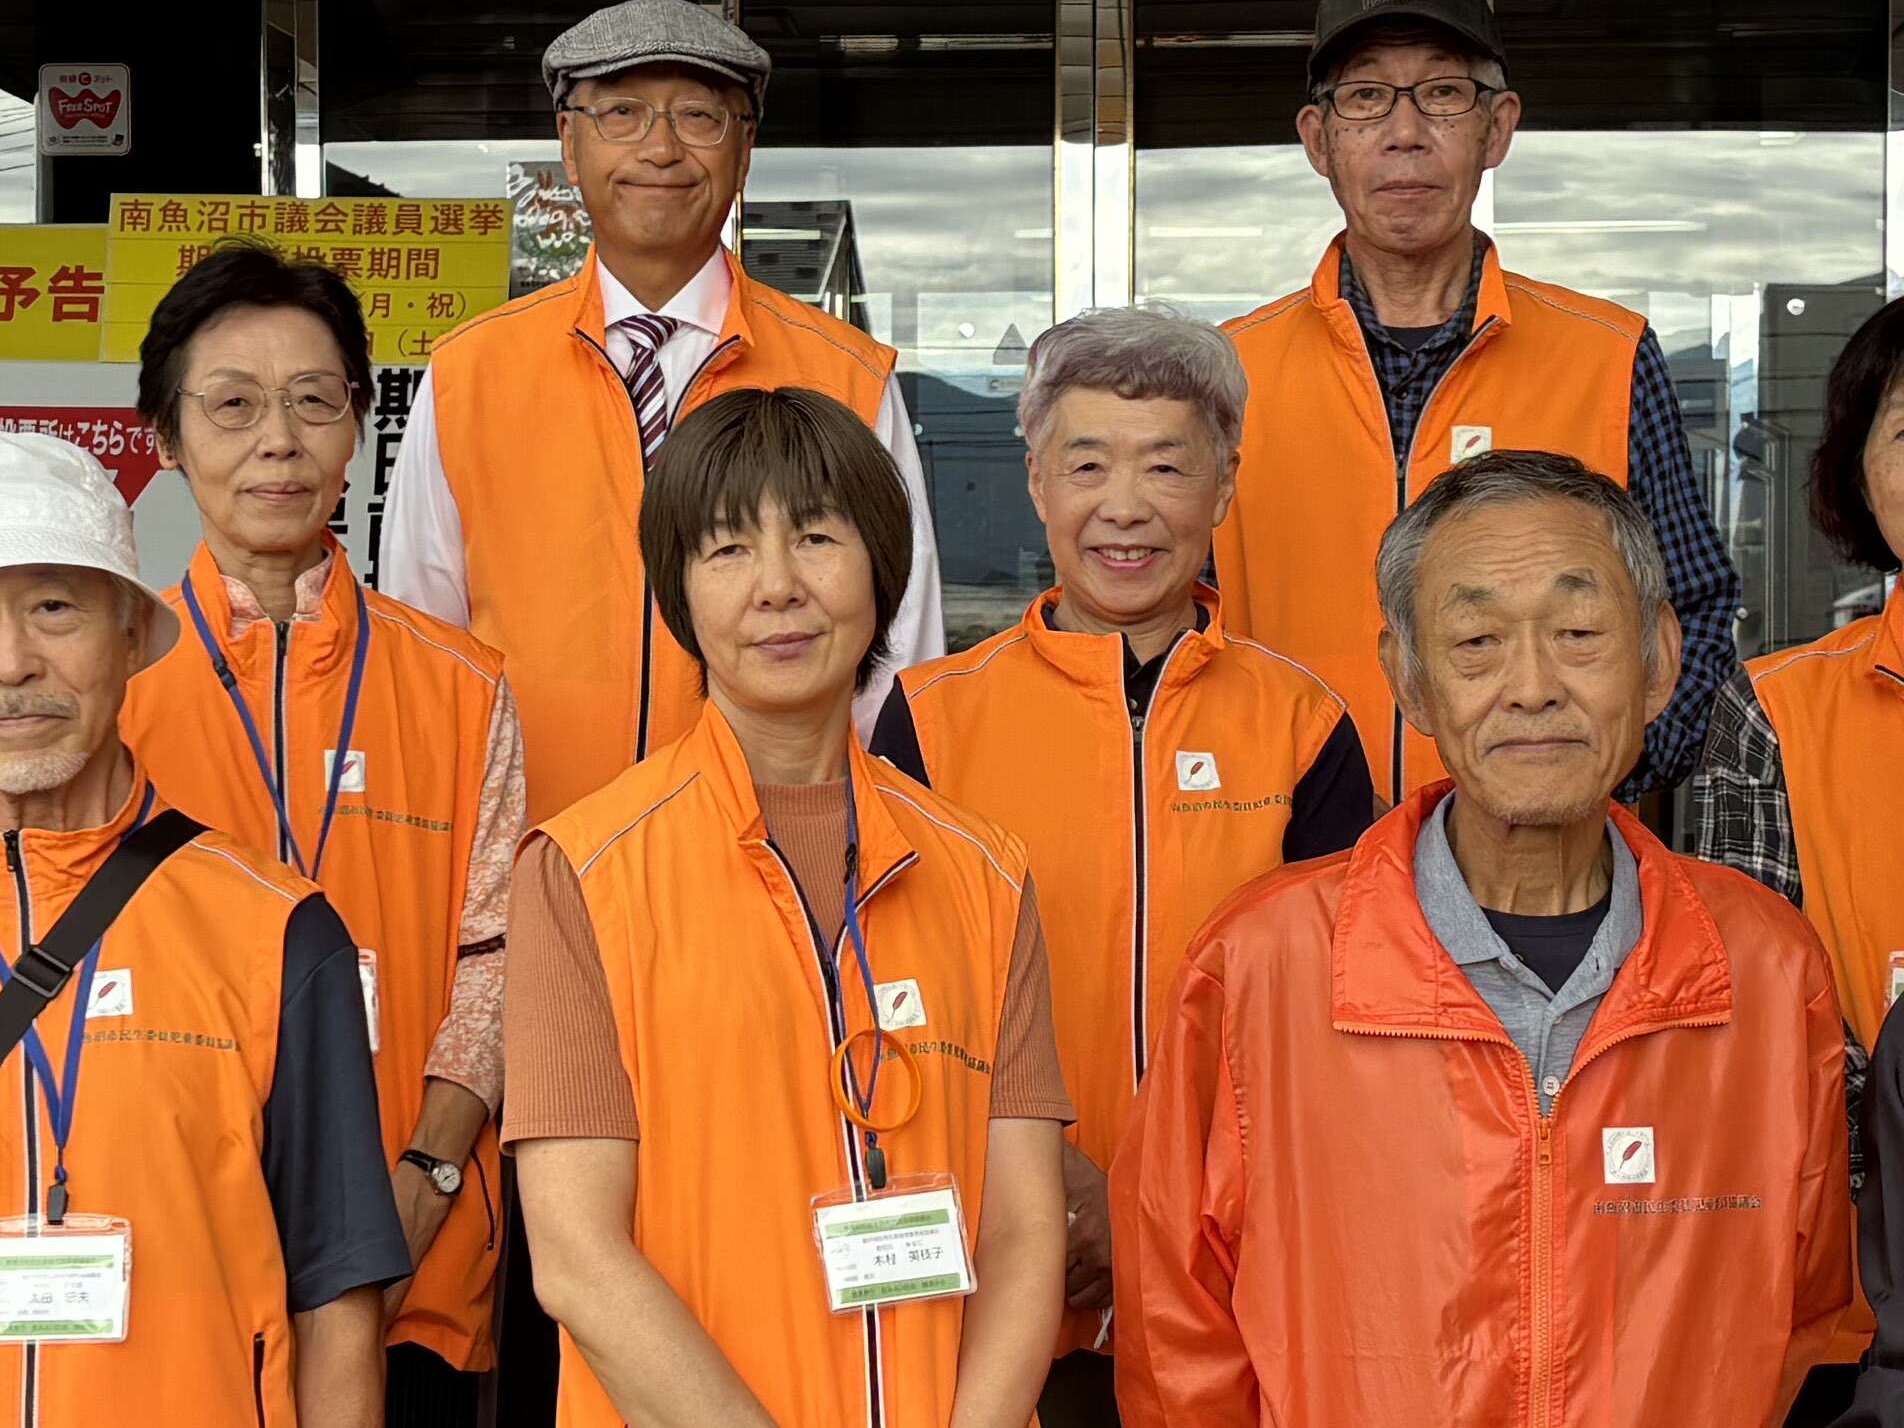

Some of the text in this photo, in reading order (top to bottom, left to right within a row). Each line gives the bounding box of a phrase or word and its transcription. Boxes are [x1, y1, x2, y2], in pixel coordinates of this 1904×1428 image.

[118, 199, 505, 237] 南魚沼市議会議員選挙
